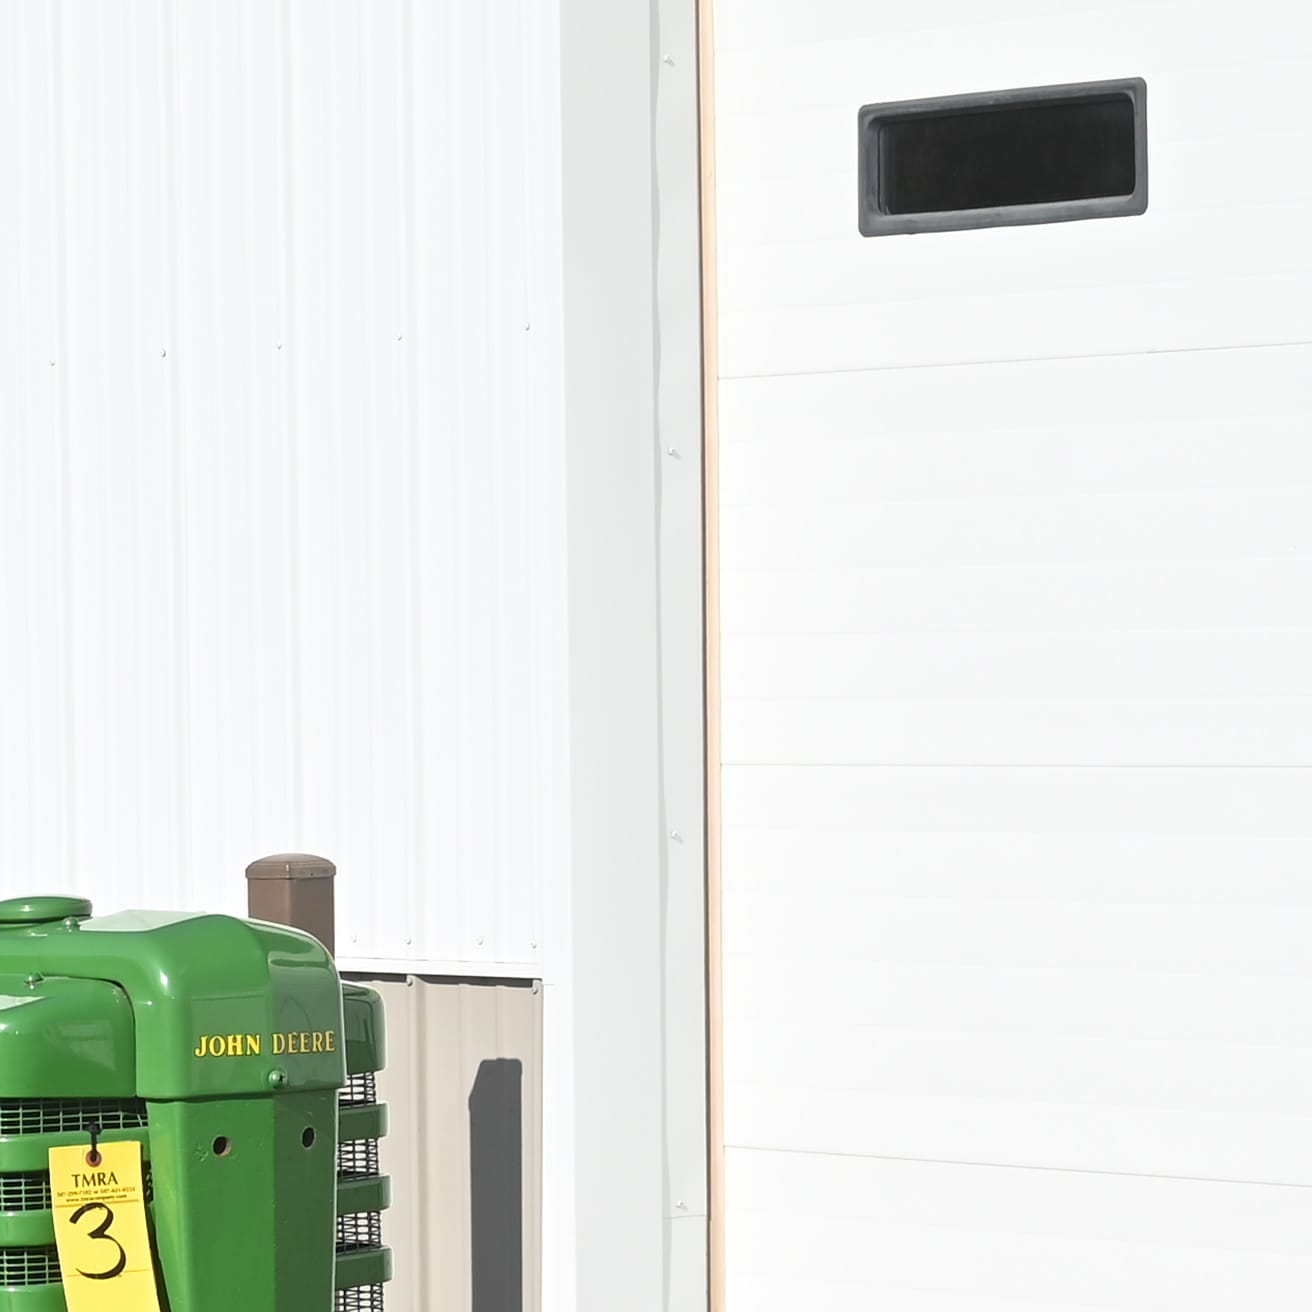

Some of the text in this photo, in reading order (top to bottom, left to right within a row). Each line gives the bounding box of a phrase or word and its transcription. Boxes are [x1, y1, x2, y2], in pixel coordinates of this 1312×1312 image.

[195, 1030, 336, 1057] JOHN DEERE
[71, 1171, 119, 1188] TMRA
[69, 1202, 127, 1280] 3
